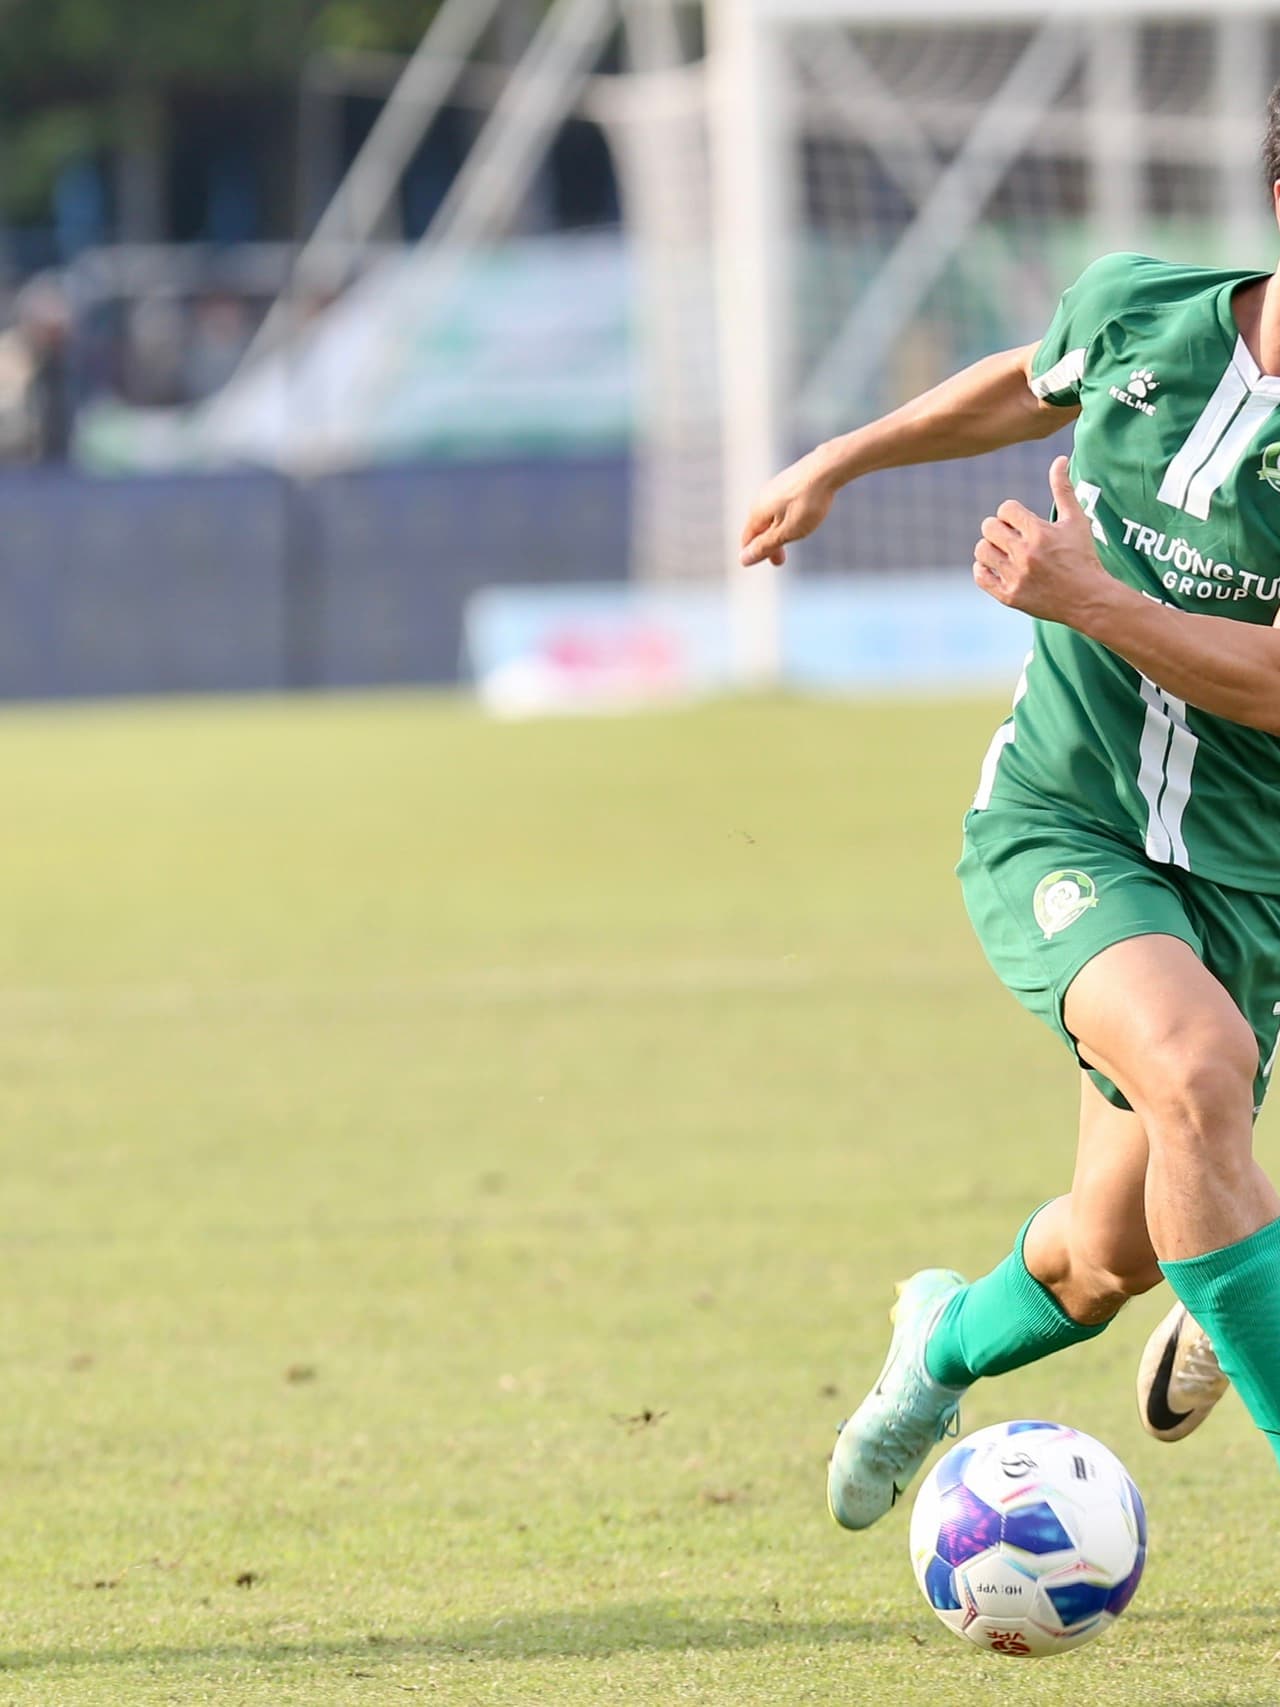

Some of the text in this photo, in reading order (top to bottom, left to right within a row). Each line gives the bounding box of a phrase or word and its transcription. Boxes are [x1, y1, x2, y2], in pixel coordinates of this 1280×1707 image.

[1109, 385, 1157, 417] KELME
[1121, 517, 1234, 581] TRƯỜNG
[1162, 570, 1249, 601] GROUP
